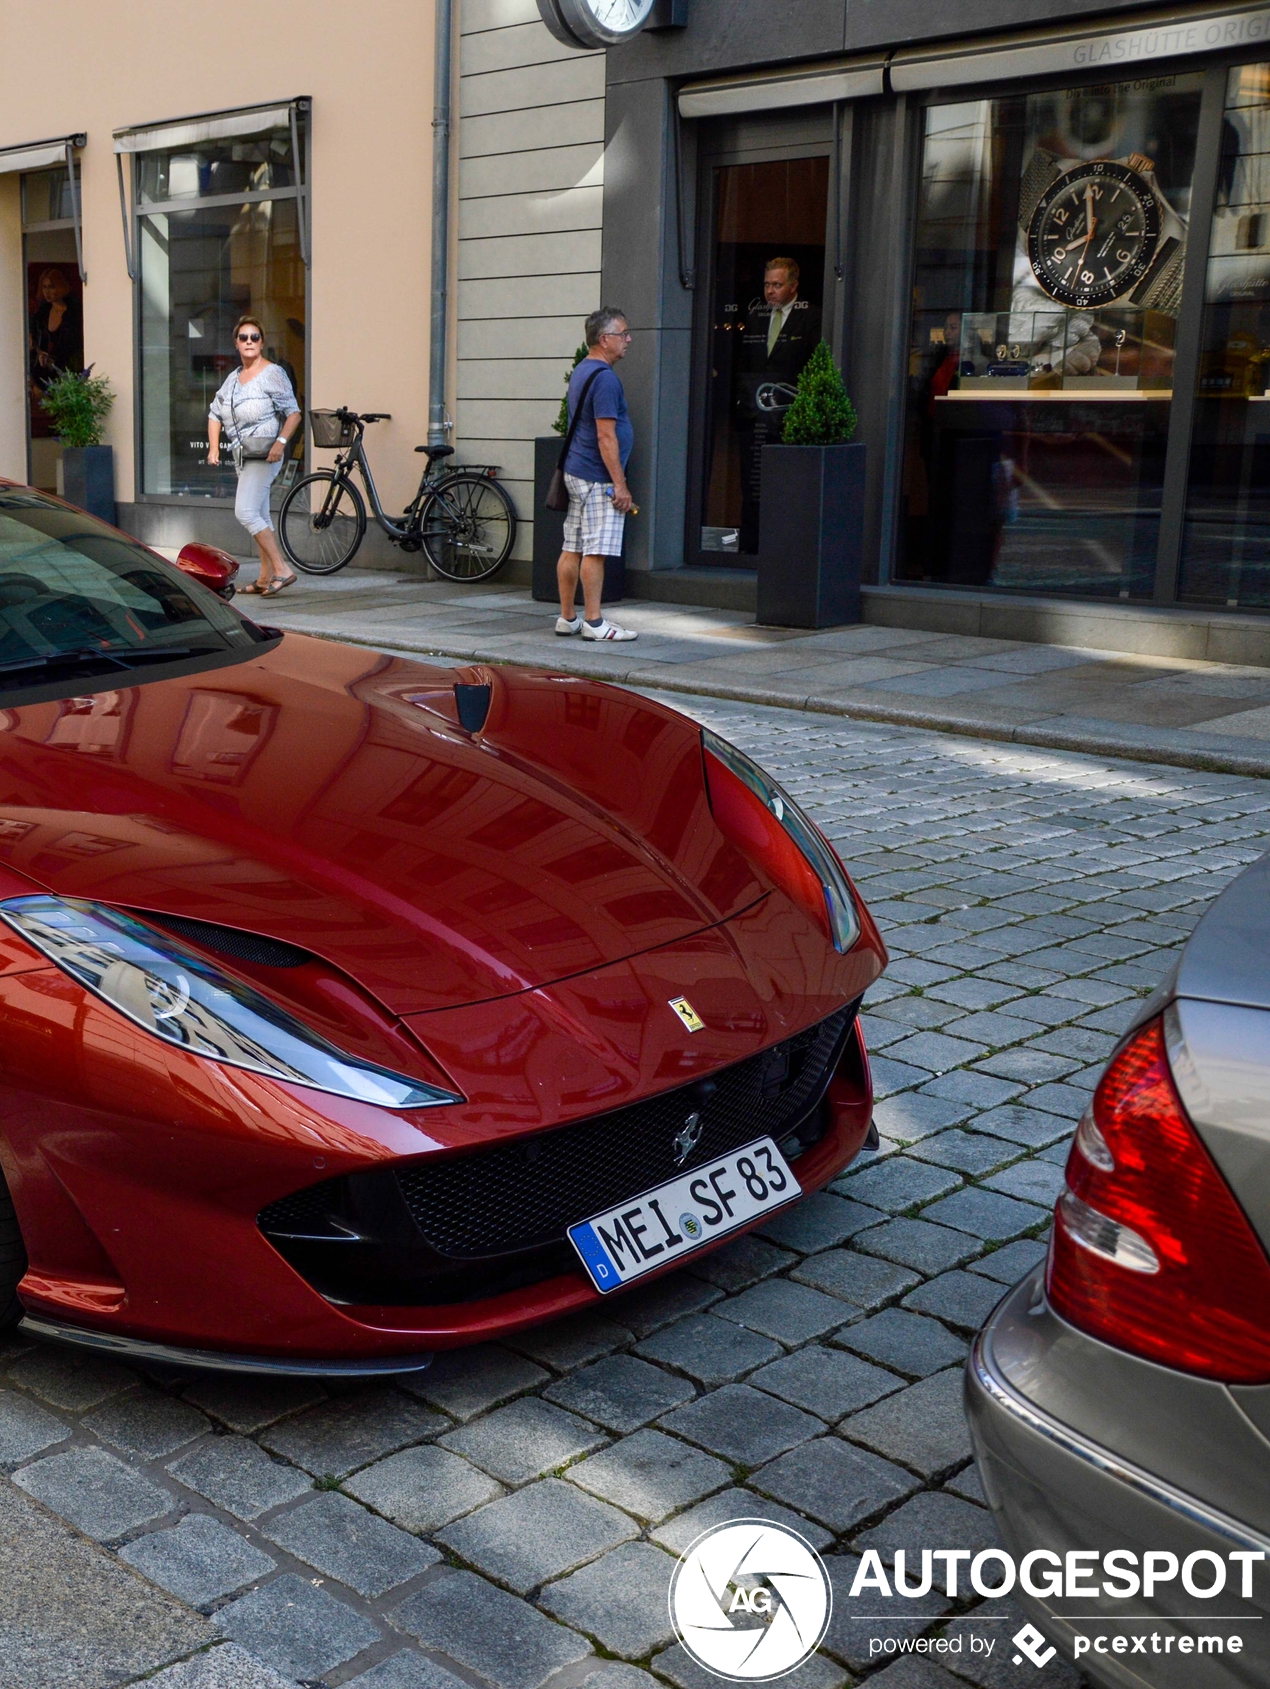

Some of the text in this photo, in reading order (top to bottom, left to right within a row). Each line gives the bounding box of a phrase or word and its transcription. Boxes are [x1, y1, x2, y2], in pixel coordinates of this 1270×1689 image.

[1073, 27, 1198, 64] GLASHÜTTE
[1133, 75, 1176, 91] Original
[1053, 208, 1070, 226] 12
[1117, 214, 1131, 230] 25
[1051, 247, 1066, 265] 10
[1116, 249, 1131, 263] 6
[1081, 270, 1094, 285] 8
[597, 1199, 684, 1272] MEI
[689, 1167, 737, 1226] SF
[736, 1145, 787, 1202] 83
[596, 1263, 609, 1279] D
